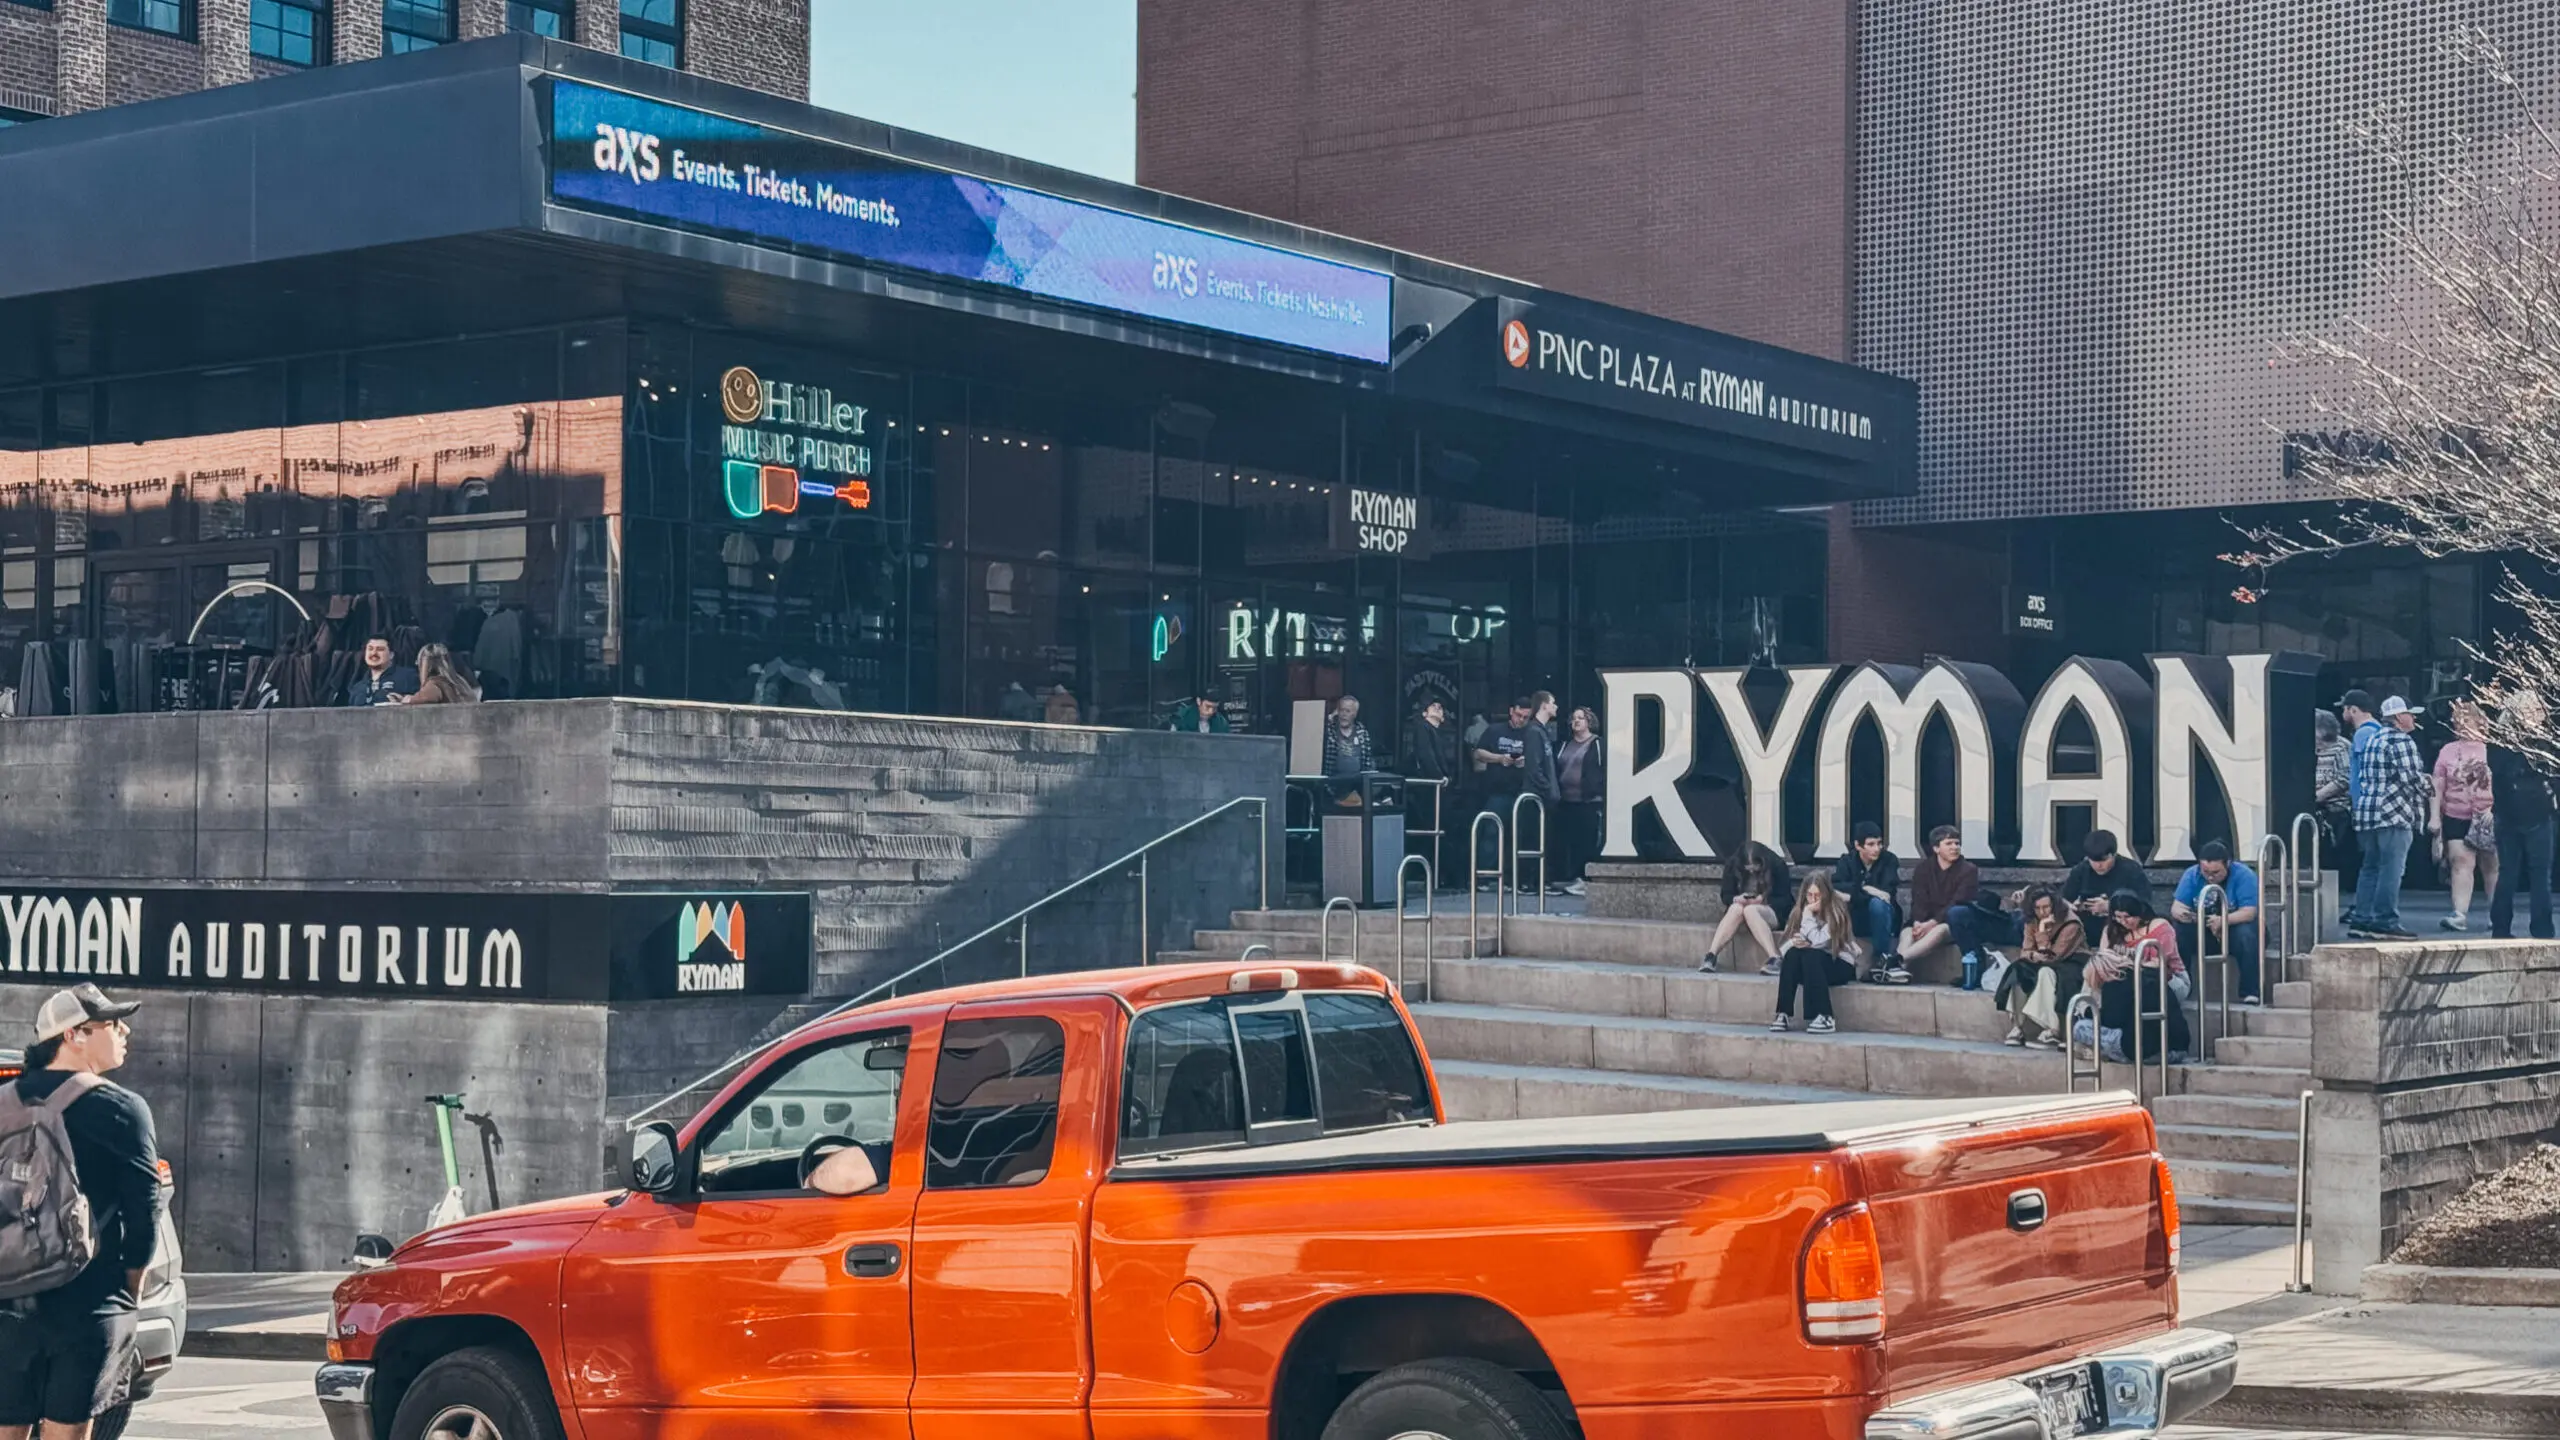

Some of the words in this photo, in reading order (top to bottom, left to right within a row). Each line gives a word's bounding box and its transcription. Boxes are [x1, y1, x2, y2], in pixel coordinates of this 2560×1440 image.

[593, 122, 661, 185] axs
[672, 149, 741, 193] Events.
[743, 163, 813, 209] Tickets.
[815, 180, 901, 228] Moments.
[1152, 250, 1201, 300] axs
[1206, 269, 1254, 303] Events.
[1255, 280, 1304, 313] Tickets.
[761, 380, 869, 435] Hiller
[1537, 329, 1595, 380] PNC
[1599, 344, 1677, 398] PLAZA
[1681, 381, 1697, 403] AT
[1699, 367, 1764, 417] RYMAN
[1768, 395, 1872, 440] AUDITORIUM
[721, 425, 796, 464] MUSIC
[803, 436, 872, 476] PORCH
[1351, 488, 1417, 530] RYMAN
[1359, 526, 1409, 553] SHOP
[2020, 616, 2032, 628] BOX
[2033, 617, 2054, 631] OFFICE
[2027, 595, 2046, 613] axs
[1600, 653, 2273, 865] RYMAN
[0, 894, 143, 976] YMAN
[168, 921, 523, 989] AUDITORIUM
[677, 962, 745, 993] RYMAN
